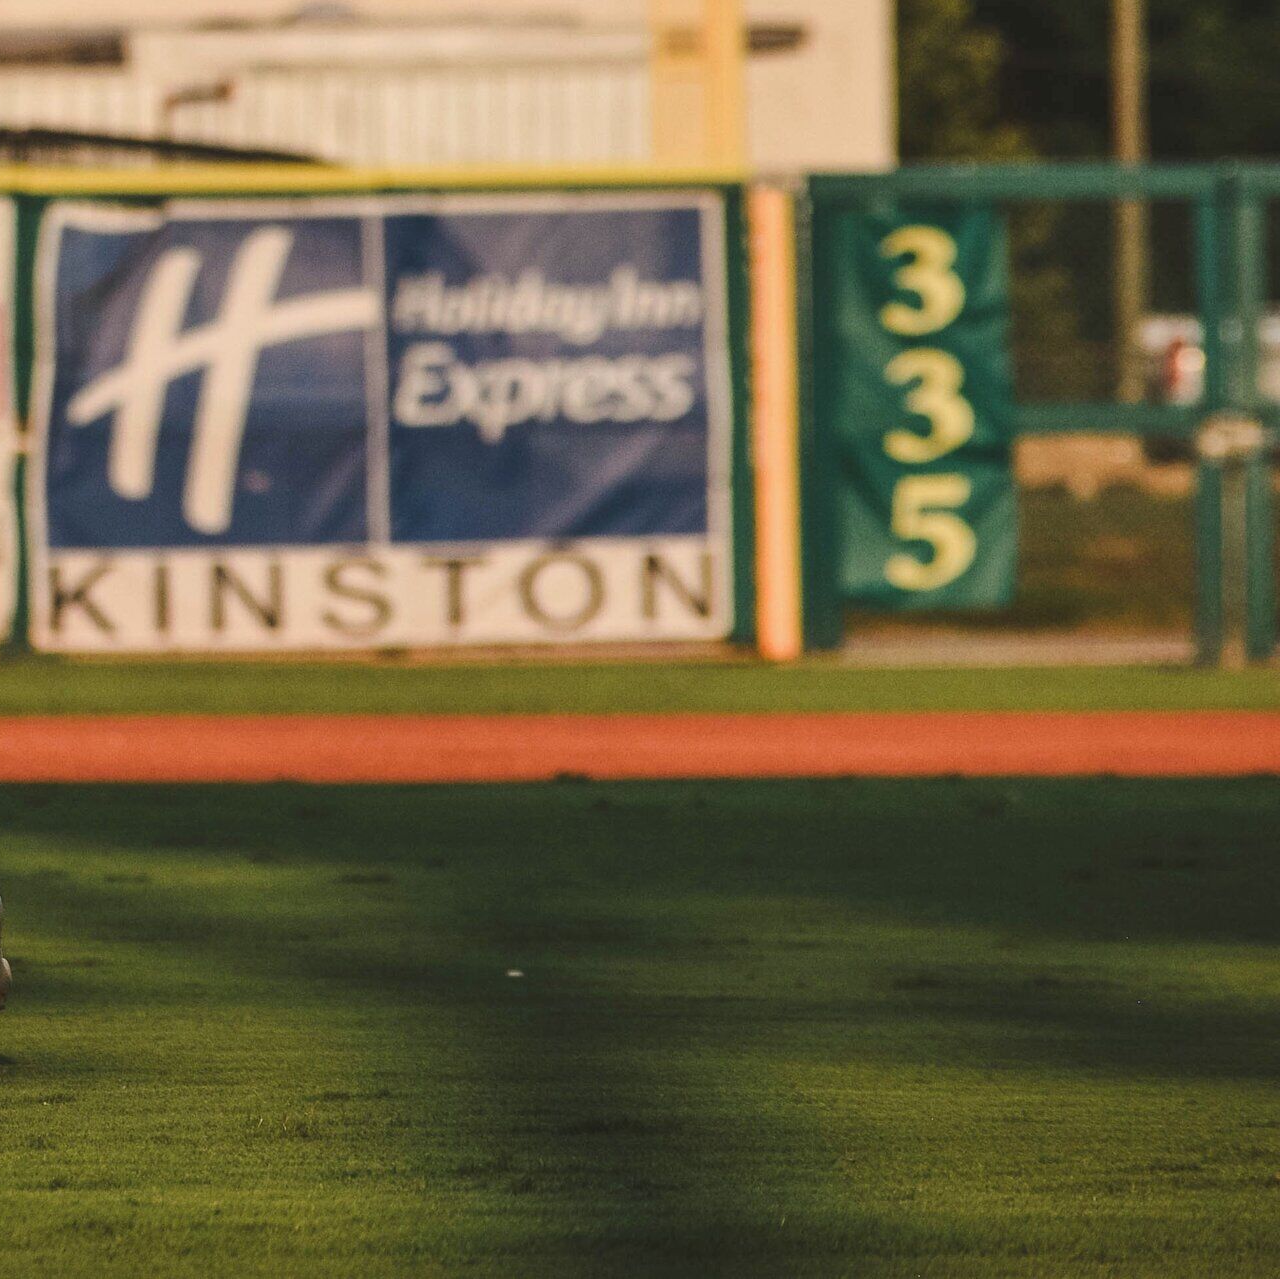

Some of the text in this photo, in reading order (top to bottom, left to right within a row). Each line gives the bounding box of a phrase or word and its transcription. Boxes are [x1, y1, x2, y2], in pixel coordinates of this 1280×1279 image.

[392, 265, 705, 345] Holiday Inn
[394, 340, 696, 445] Express
[48, 554, 715, 634] KINSTON
